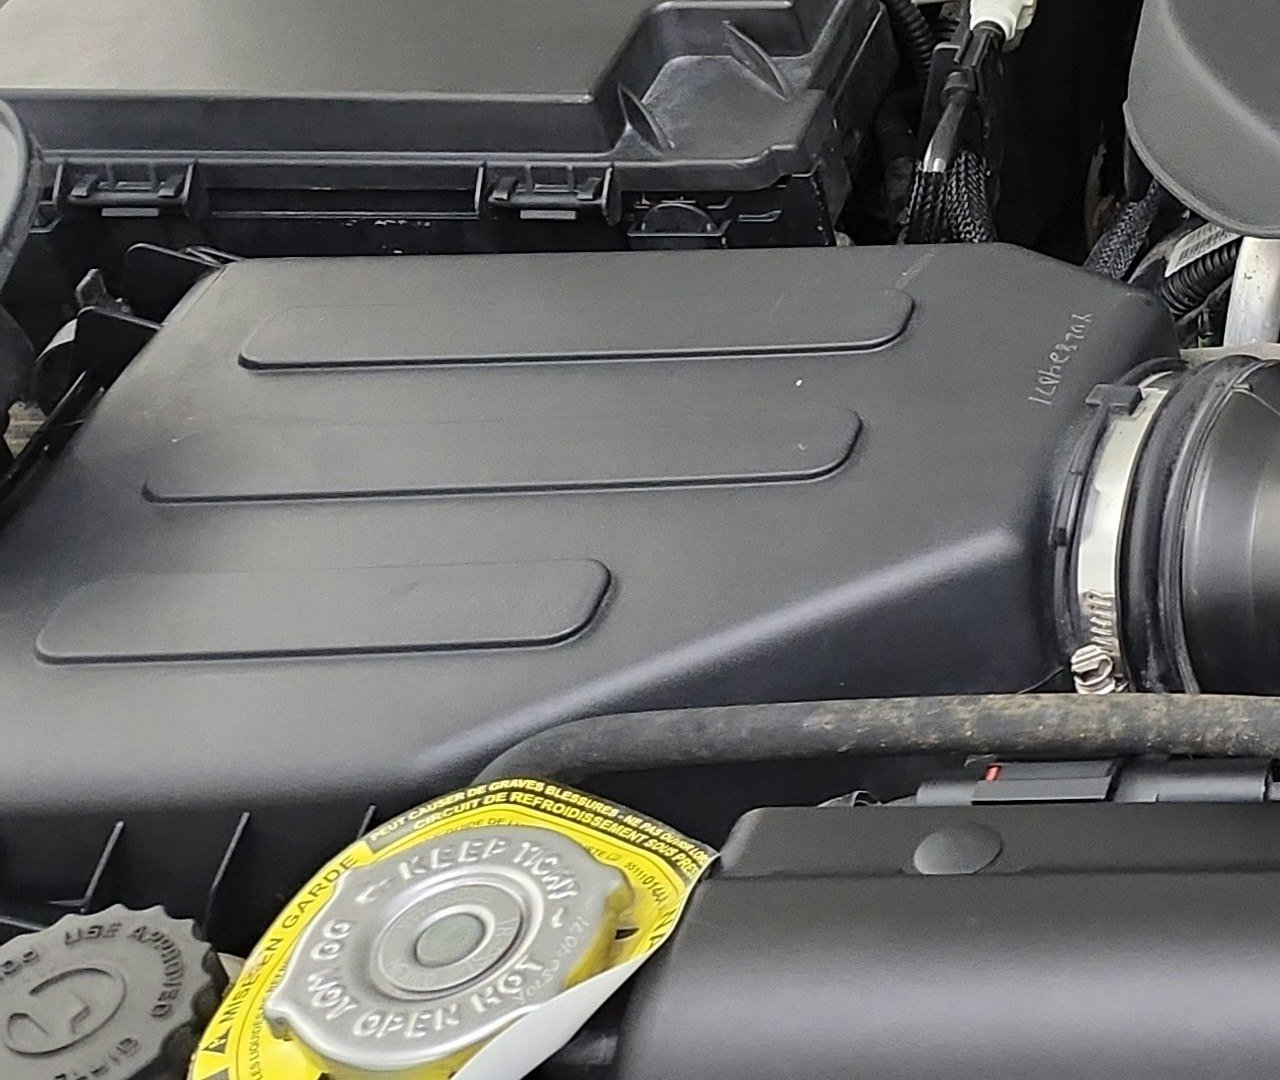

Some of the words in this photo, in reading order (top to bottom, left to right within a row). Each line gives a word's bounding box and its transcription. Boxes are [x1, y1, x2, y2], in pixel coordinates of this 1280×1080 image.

[370, 816, 405, 841] PEUT
[409, 791, 466, 820] CAUSER
[466, 783, 488, 797] DE
[487, 779, 545, 795] GRAVES
[545, 785, 619, 819] BLESSURES
[623, 814, 641, 829] NE
[639, 819, 664, 837] PAS
[413, 798, 481, 830] CIRCUIT
[482, 791, 509, 804] DE
[510, 792, 652, 846] REFROIDISSEMENT
[646, 837, 677, 860] SOUS
[282, 854, 358, 930] GARDE
[398, 836, 511, 881] KEEP
[353, 996, 461, 1039] OPEN
[468, 958, 544, 1014] HOT
